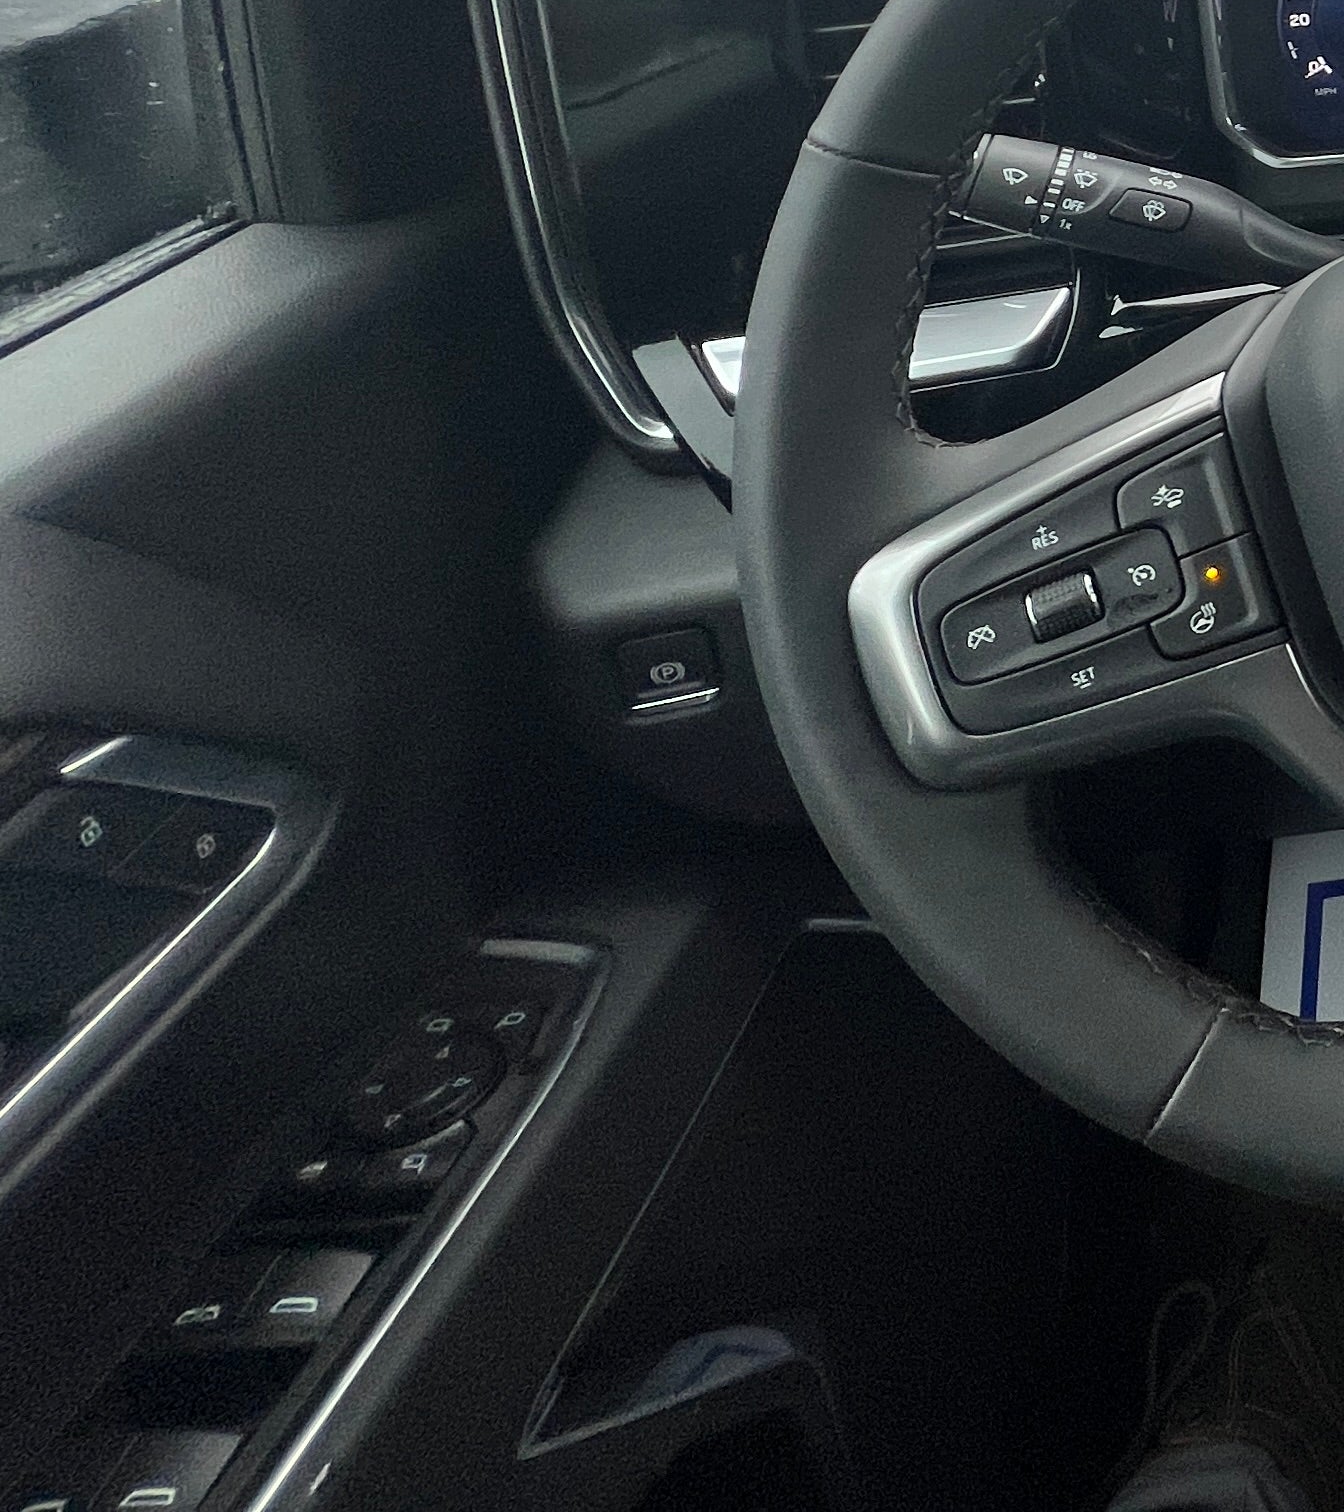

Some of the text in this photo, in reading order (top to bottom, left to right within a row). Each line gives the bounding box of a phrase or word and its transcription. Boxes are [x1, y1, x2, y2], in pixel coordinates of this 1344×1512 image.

[1289, 13, 1311, 27] 20
[1062, 197, 1085, 212] OFF
[1031, 530, 1059, 550] RES
[1070, 666, 1095, 687] SET
